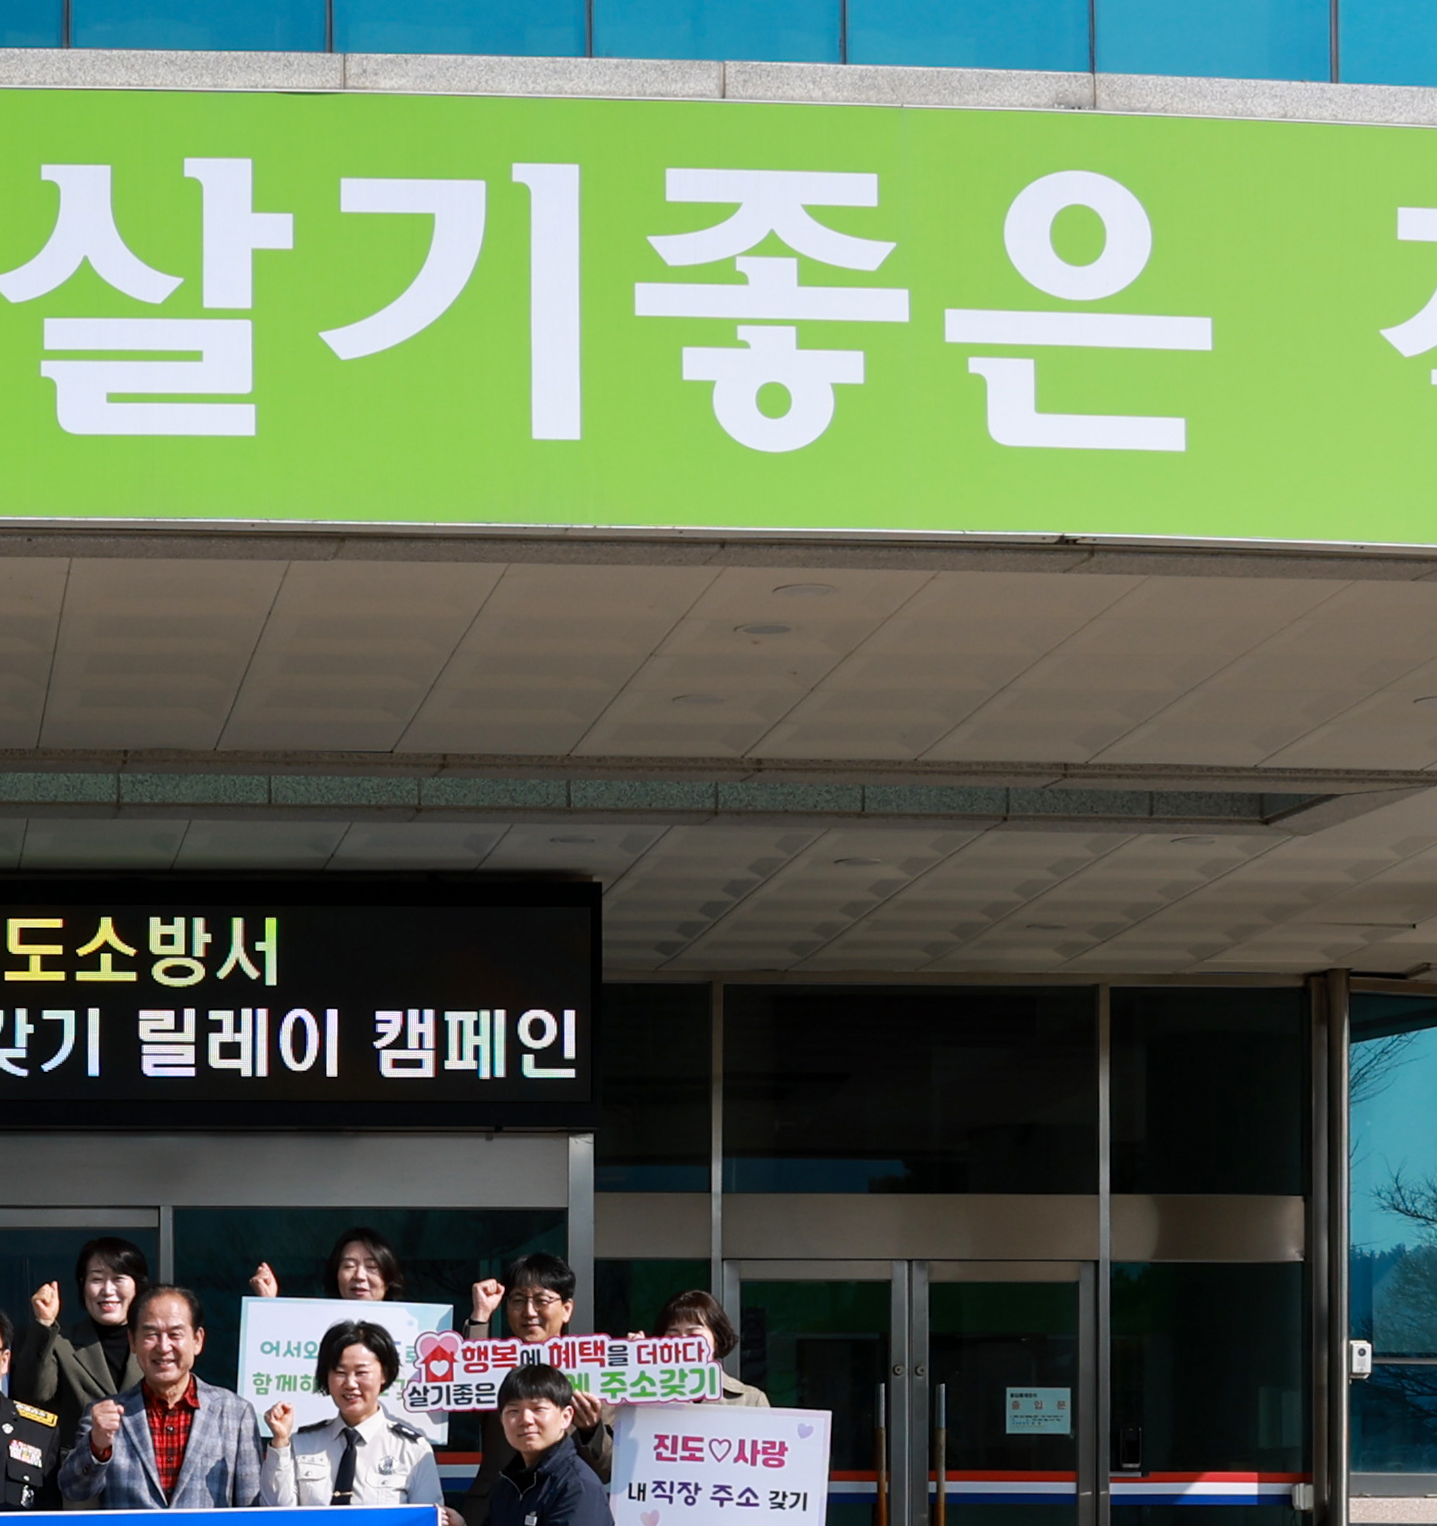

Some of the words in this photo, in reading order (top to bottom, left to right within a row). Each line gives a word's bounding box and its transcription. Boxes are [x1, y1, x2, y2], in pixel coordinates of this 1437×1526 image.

[138, 1007, 339, 1078] 릴레이
[372, 1007, 578, 1079] 캠페인
[461, 1344, 541, 1374] 행복에
[548, 1339, 630, 1370] 혜택을
[636, 1340, 706, 1365] 더하다
[407, 1381, 497, 1408] 살기좋은
[600, 1365, 717, 1399] 주소갖기
[653, 1434, 705, 1462] 진도
[733, 1439, 789, 1468] 사랑
[628, 1482, 647, 1502] 내
[651, 1480, 702, 1506] 직장
[710, 1484, 760, 1508] 주소
[768, 1490, 808, 1512] 갖기
